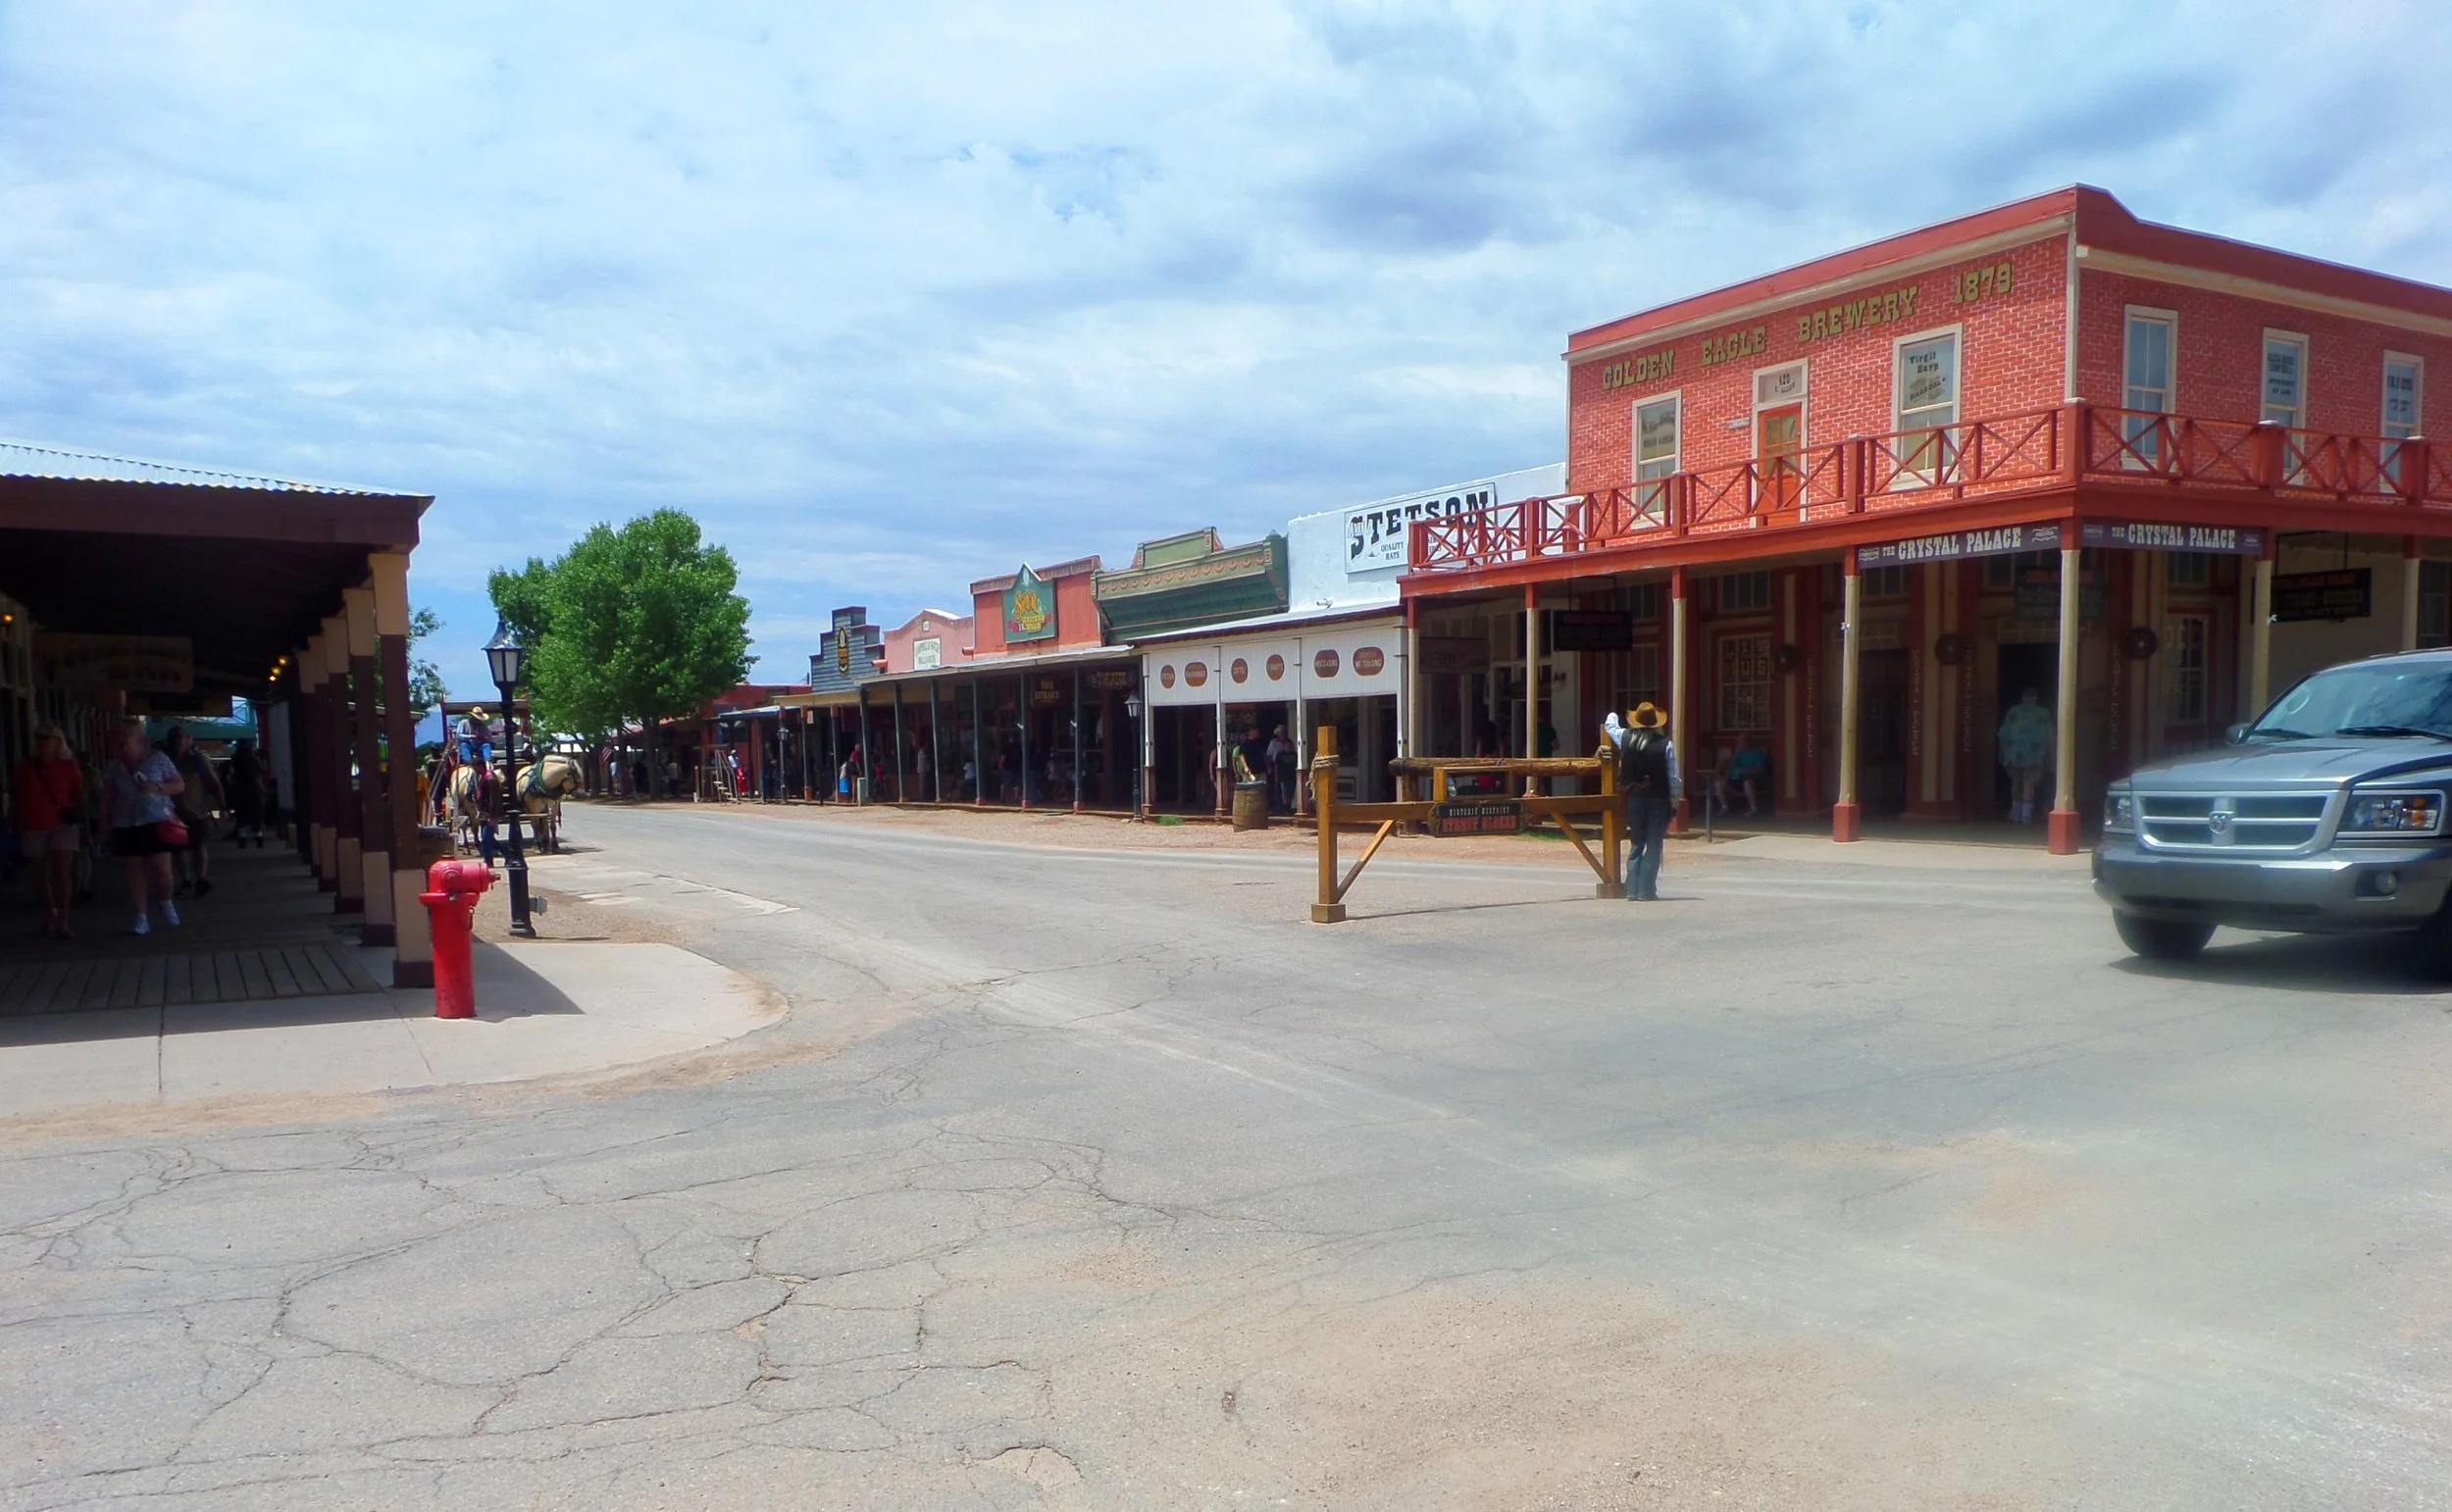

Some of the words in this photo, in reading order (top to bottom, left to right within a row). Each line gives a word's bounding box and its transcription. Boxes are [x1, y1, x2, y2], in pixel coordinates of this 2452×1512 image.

[1603, 348, 1676, 390] GOLDEN
[1701, 326, 1766, 367] EAGLE
[1797, 286, 1918, 342] BREWERY
[1954, 263, 2013, 303] 1879
[1910, 351, 1936, 364] Virgil
[1917, 363, 1939, 374] Earp
[1351, 491, 1489, 561] STETSON
[1882, 545, 1895, 557] THE
[1898, 534, 1960, 561] CRYSTAL
[1966, 527, 2021, 553] PALACE
[2111, 527, 2124, 537] THE
[2128, 524, 2184, 546] CRYSTAL
[2189, 527, 2235, 549] PALACE
[1381, 541, 1405, 552] QUALITY
[1385, 551, 1400, 561] HATS
